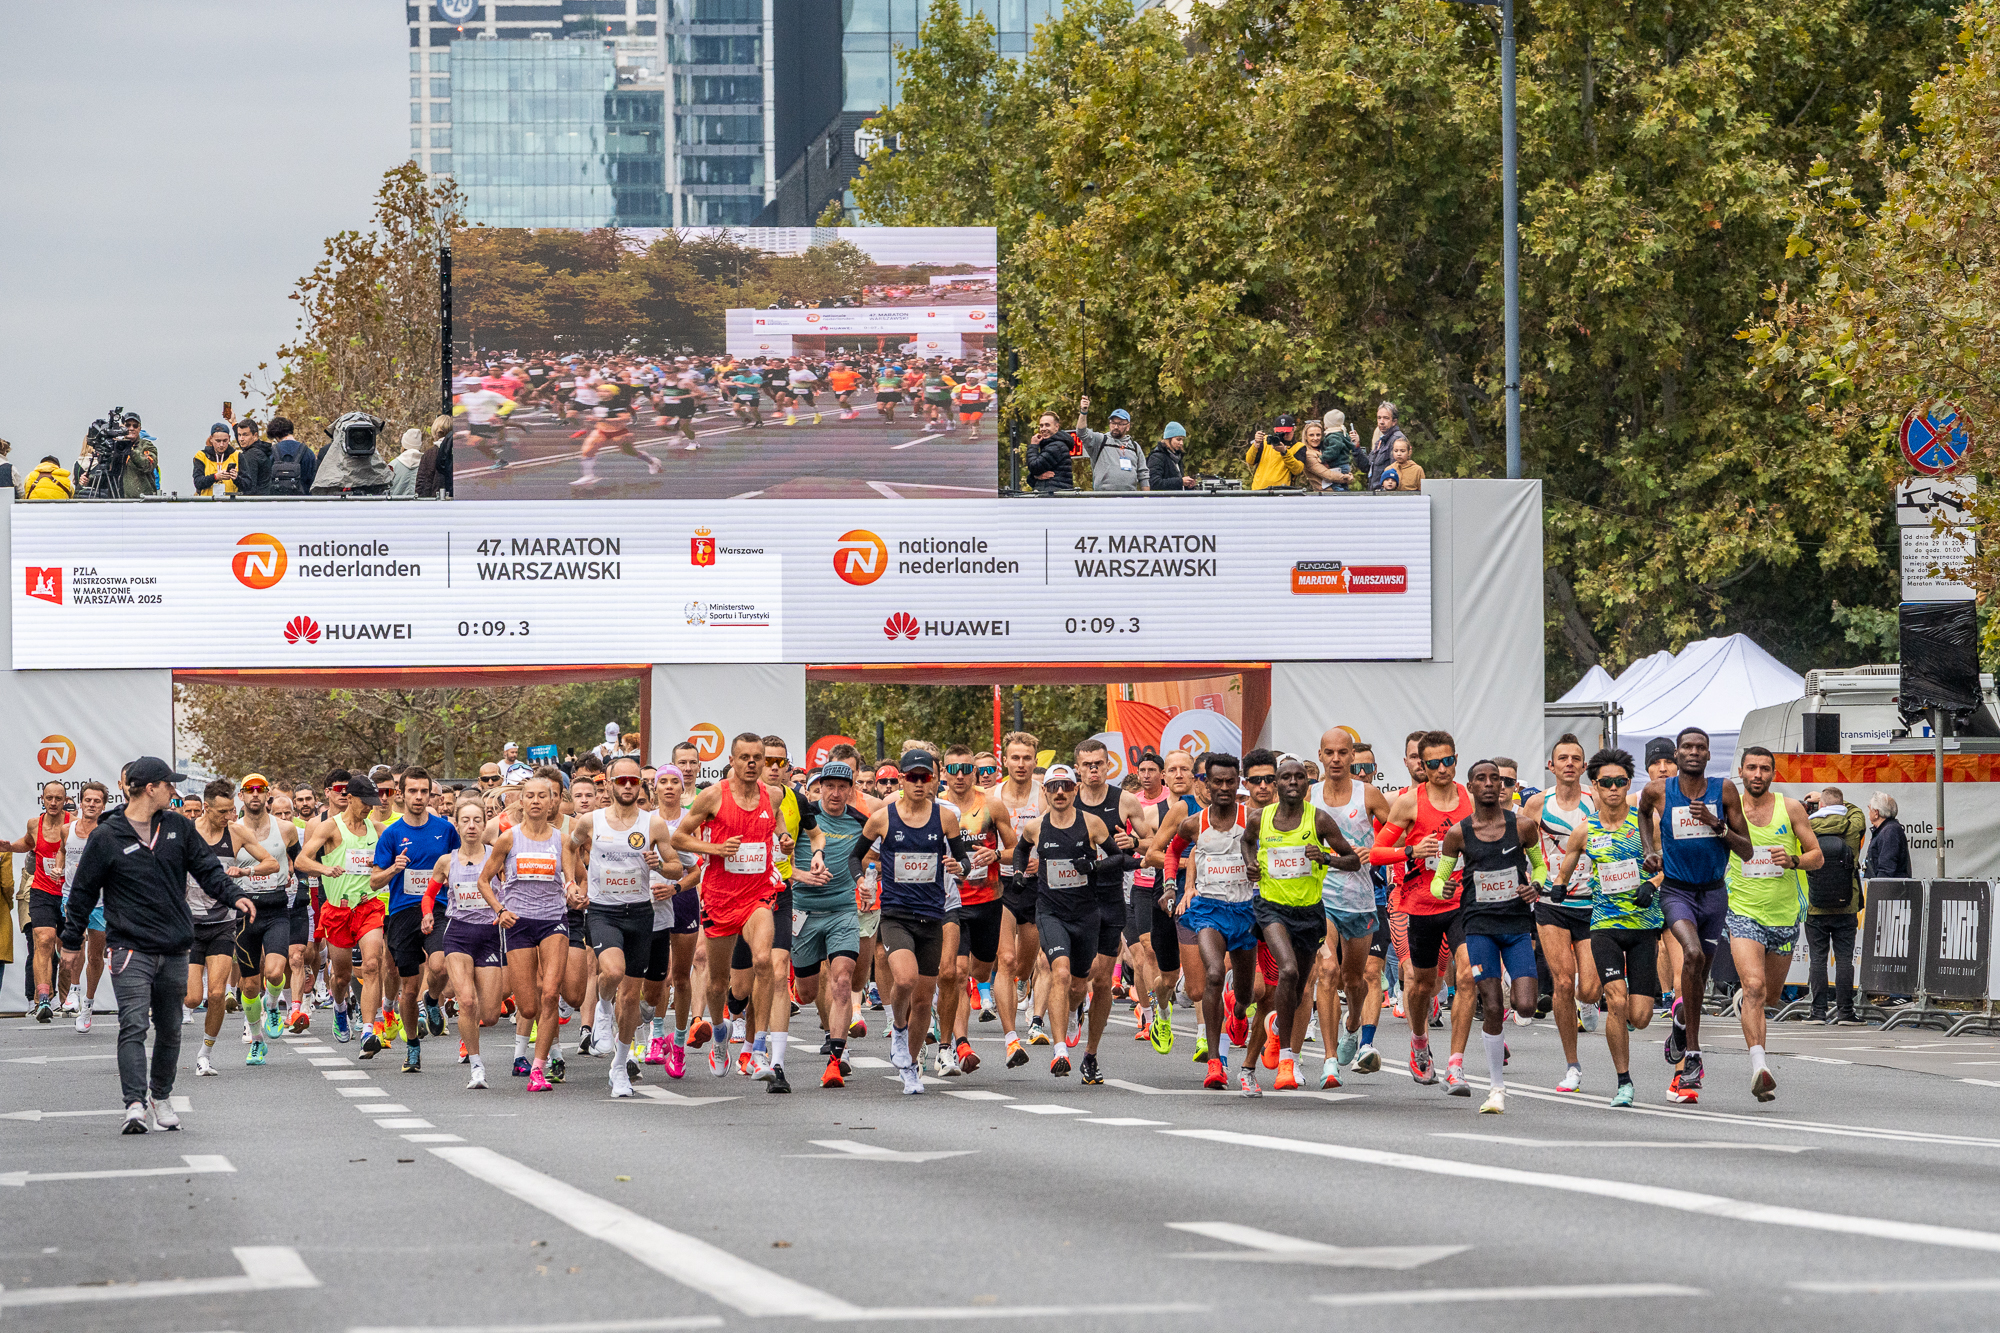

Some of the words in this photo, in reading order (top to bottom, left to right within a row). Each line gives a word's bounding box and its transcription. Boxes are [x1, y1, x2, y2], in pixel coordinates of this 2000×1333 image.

[298, 539, 390, 557] nationale
[476, 539, 506, 557] 47.
[511, 537, 621, 556] MARATON
[899, 536, 988, 554] nationale
[1074, 536, 1103, 554] 47.
[1108, 534, 1217, 554] MARATON
[718, 546, 764, 556] Warszawa
[298, 559, 421, 578] nederlanden
[899, 556, 1019, 574] nederlanden
[1074, 558, 1217, 578] WARSZAWSKI
[73, 567, 98, 576] PZLA
[476, 561, 621, 581] WARSZAWSKI
[1298, 575, 1338, 585] MARATON
[1352, 574, 1404, 584] WARSZAWSKI
[74, 595, 135, 604] WARSZAWA
[138, 594, 162, 604] 2025
[710, 603, 755, 612] Ministerstwo
[709, 612, 733, 621] Sportu
[739, 612, 770, 621] Turystyki
[458, 620, 530, 637] 0:09.3
[924, 620, 1010, 637] HUAWEI
[1065, 618, 1141, 634] 0:09.3
[326, 624, 412, 640] HUAWEI
[1840, 730, 1892, 740] transmisjeli
[728, 854, 764, 863] OLEJARZ
[1274, 858, 1297, 867] PACE
[1300, 858, 1305, 866] 3
[904, 862, 928, 870] 6012
[1208, 865, 1245, 874] PAUVERT
[1058, 870, 1077, 878] M20
[1602, 871, 1636, 882] TAKEUCHI
[1482, 881, 1505, 891] PACE
[1508, 880, 1513, 888] 2
[1938, 966, 1960, 975] ISOTONIC
